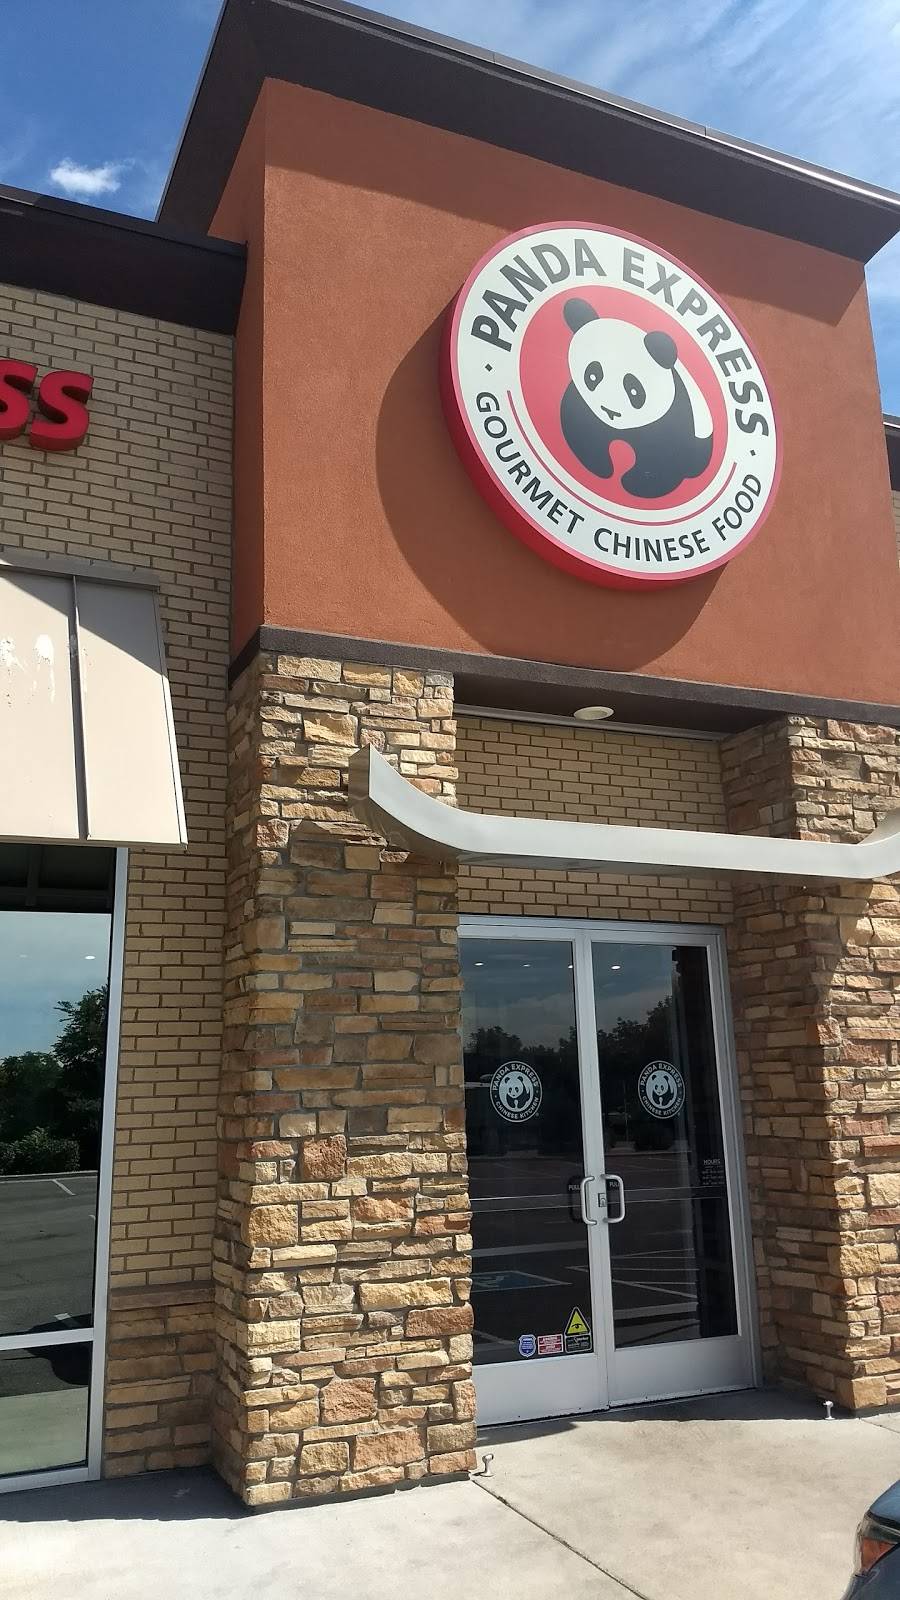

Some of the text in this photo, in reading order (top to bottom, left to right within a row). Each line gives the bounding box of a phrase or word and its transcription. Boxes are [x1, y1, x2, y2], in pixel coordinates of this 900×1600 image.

[470, 238, 769, 438] PANDA EXPRESS
[476, 391, 762, 562] GOURMET CHINESE FOOD
[492, 1063, 539, 1091] PANDA EXPRESS
[640, 1063, 683, 1088] PANDA EXPRESS
[495, 1096, 540, 1119] CHINESE KITCHEN
[642, 1095, 662, 1116] CHINESE
